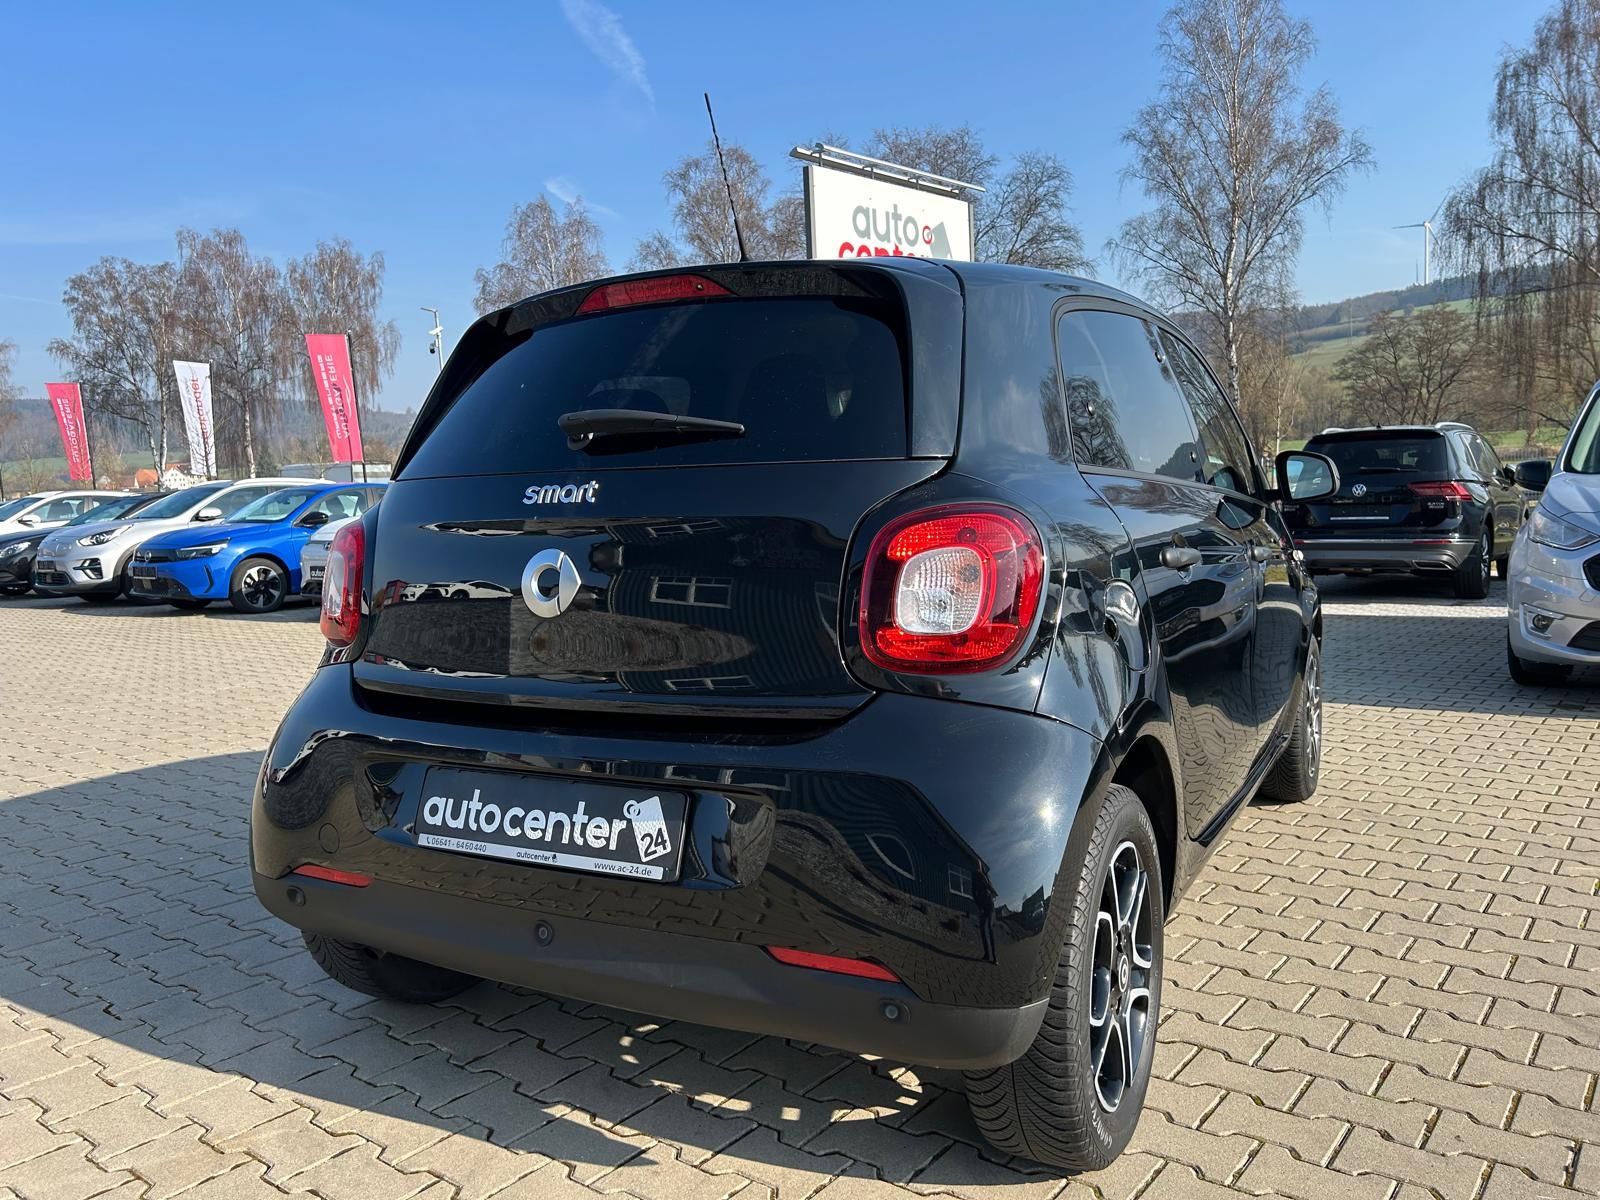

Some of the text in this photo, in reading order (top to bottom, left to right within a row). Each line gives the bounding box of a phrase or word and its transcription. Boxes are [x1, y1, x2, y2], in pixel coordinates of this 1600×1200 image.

[852, 203, 919, 247] auto
[522, 480, 599, 505] smart
[423, 788, 667, 858] autocenter 24
[516, 851, 551, 862] autocenter
[594, 861, 652, 876] www.ac-24.de
